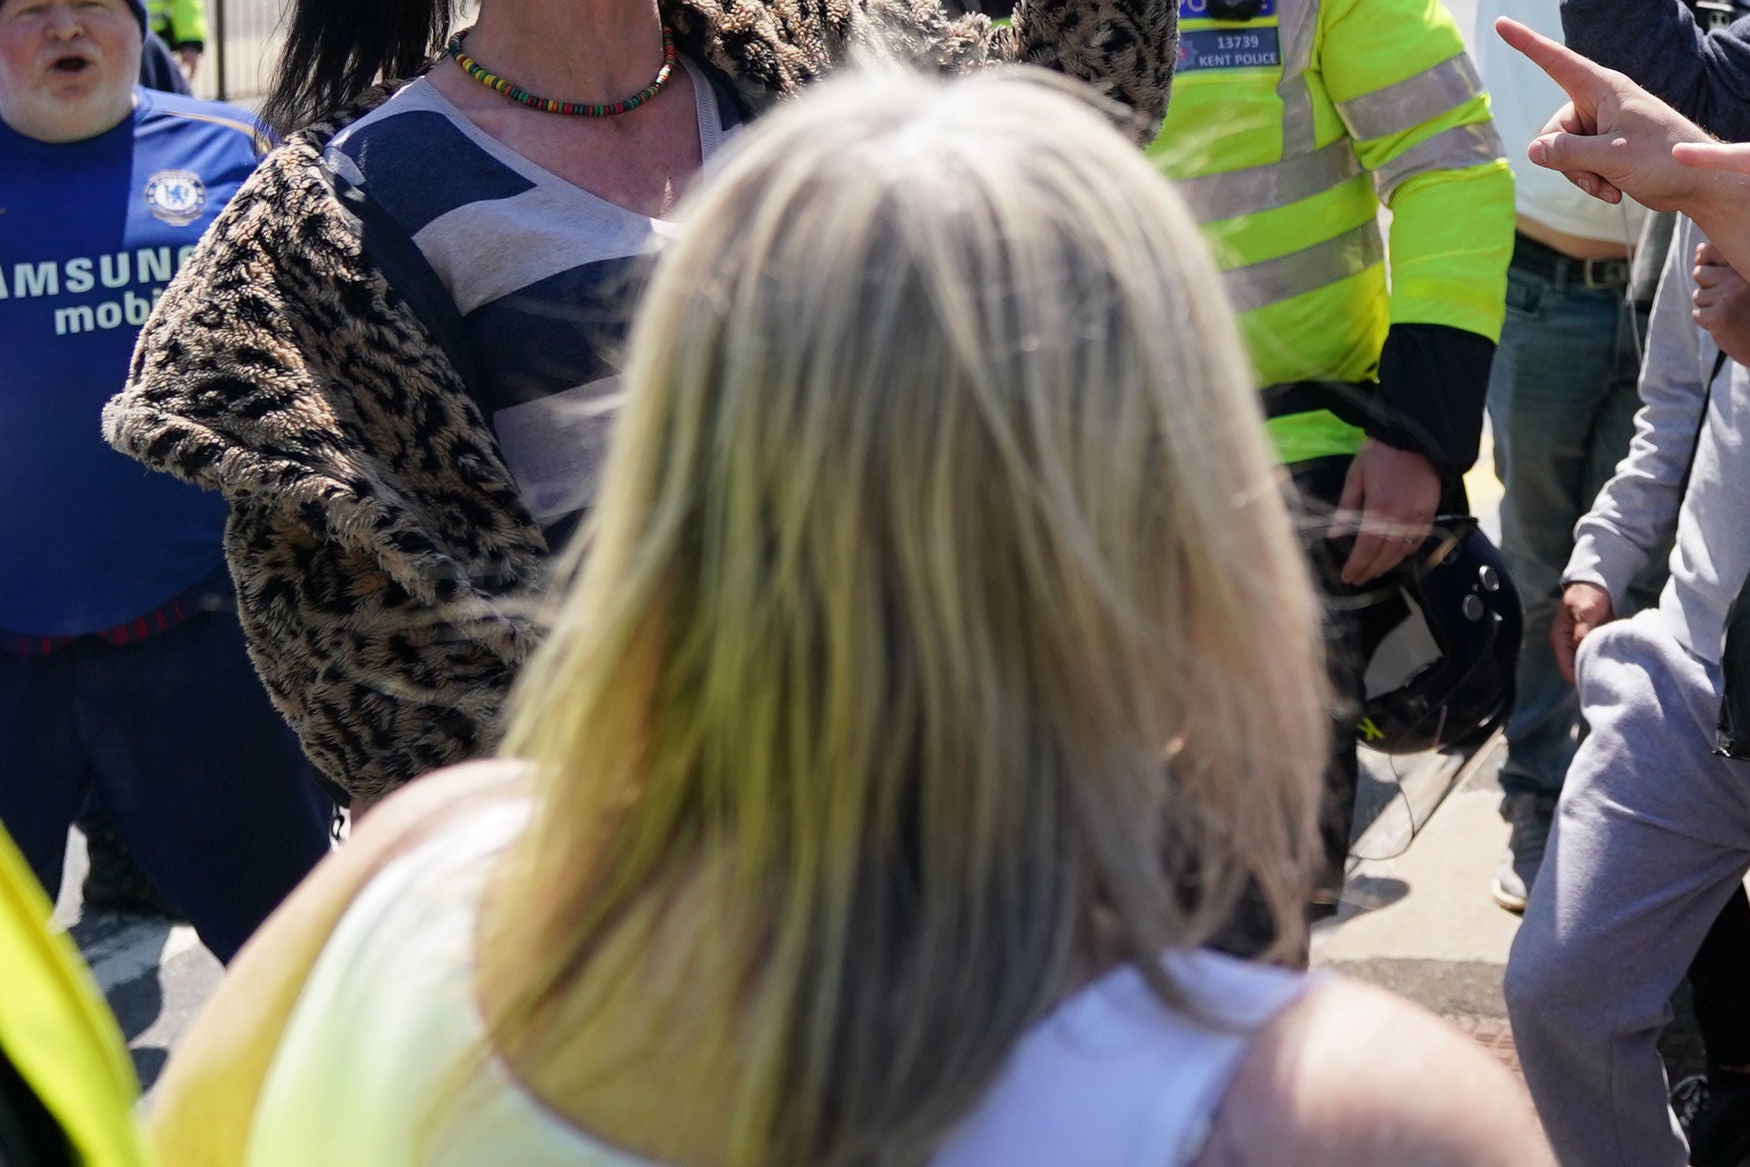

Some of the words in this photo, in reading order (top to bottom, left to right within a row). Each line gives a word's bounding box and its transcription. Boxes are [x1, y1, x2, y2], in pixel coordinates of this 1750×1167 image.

[1217, 36, 1260, 50] 13739
[1199, 55, 1232, 67] KENT
[1235, 53, 1278, 66] POLICE
